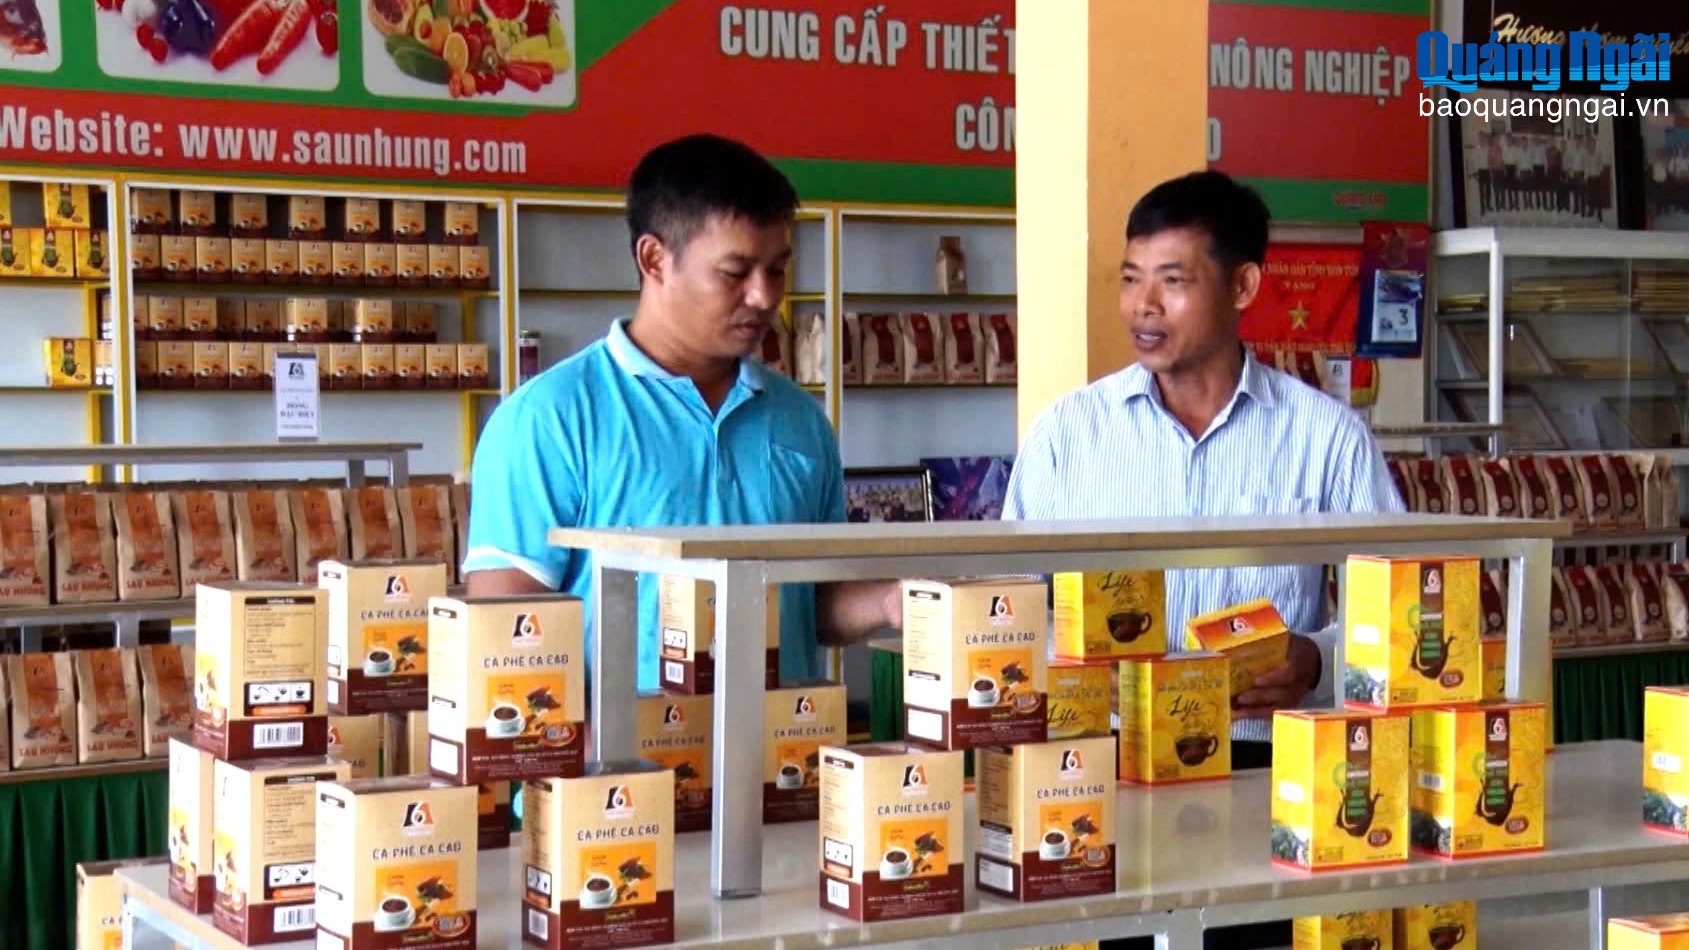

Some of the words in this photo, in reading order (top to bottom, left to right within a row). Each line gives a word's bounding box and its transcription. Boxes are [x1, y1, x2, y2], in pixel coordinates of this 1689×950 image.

[719, 5, 820, 61] CUNG
[834, 4, 907, 67] CẤP
[1210, 37, 1293, 91] NÔNG
[1304, 46, 1410, 106] NGHIỆP
[0, 106, 163, 157] Website:
[179, 124, 527, 176] www.saunhung.com
[1399, 308, 1408, 325] 3
[1097, 571, 1136, 597] Life
[414, 608, 428, 617] CA
[1166, 695, 1200, 723] Life
